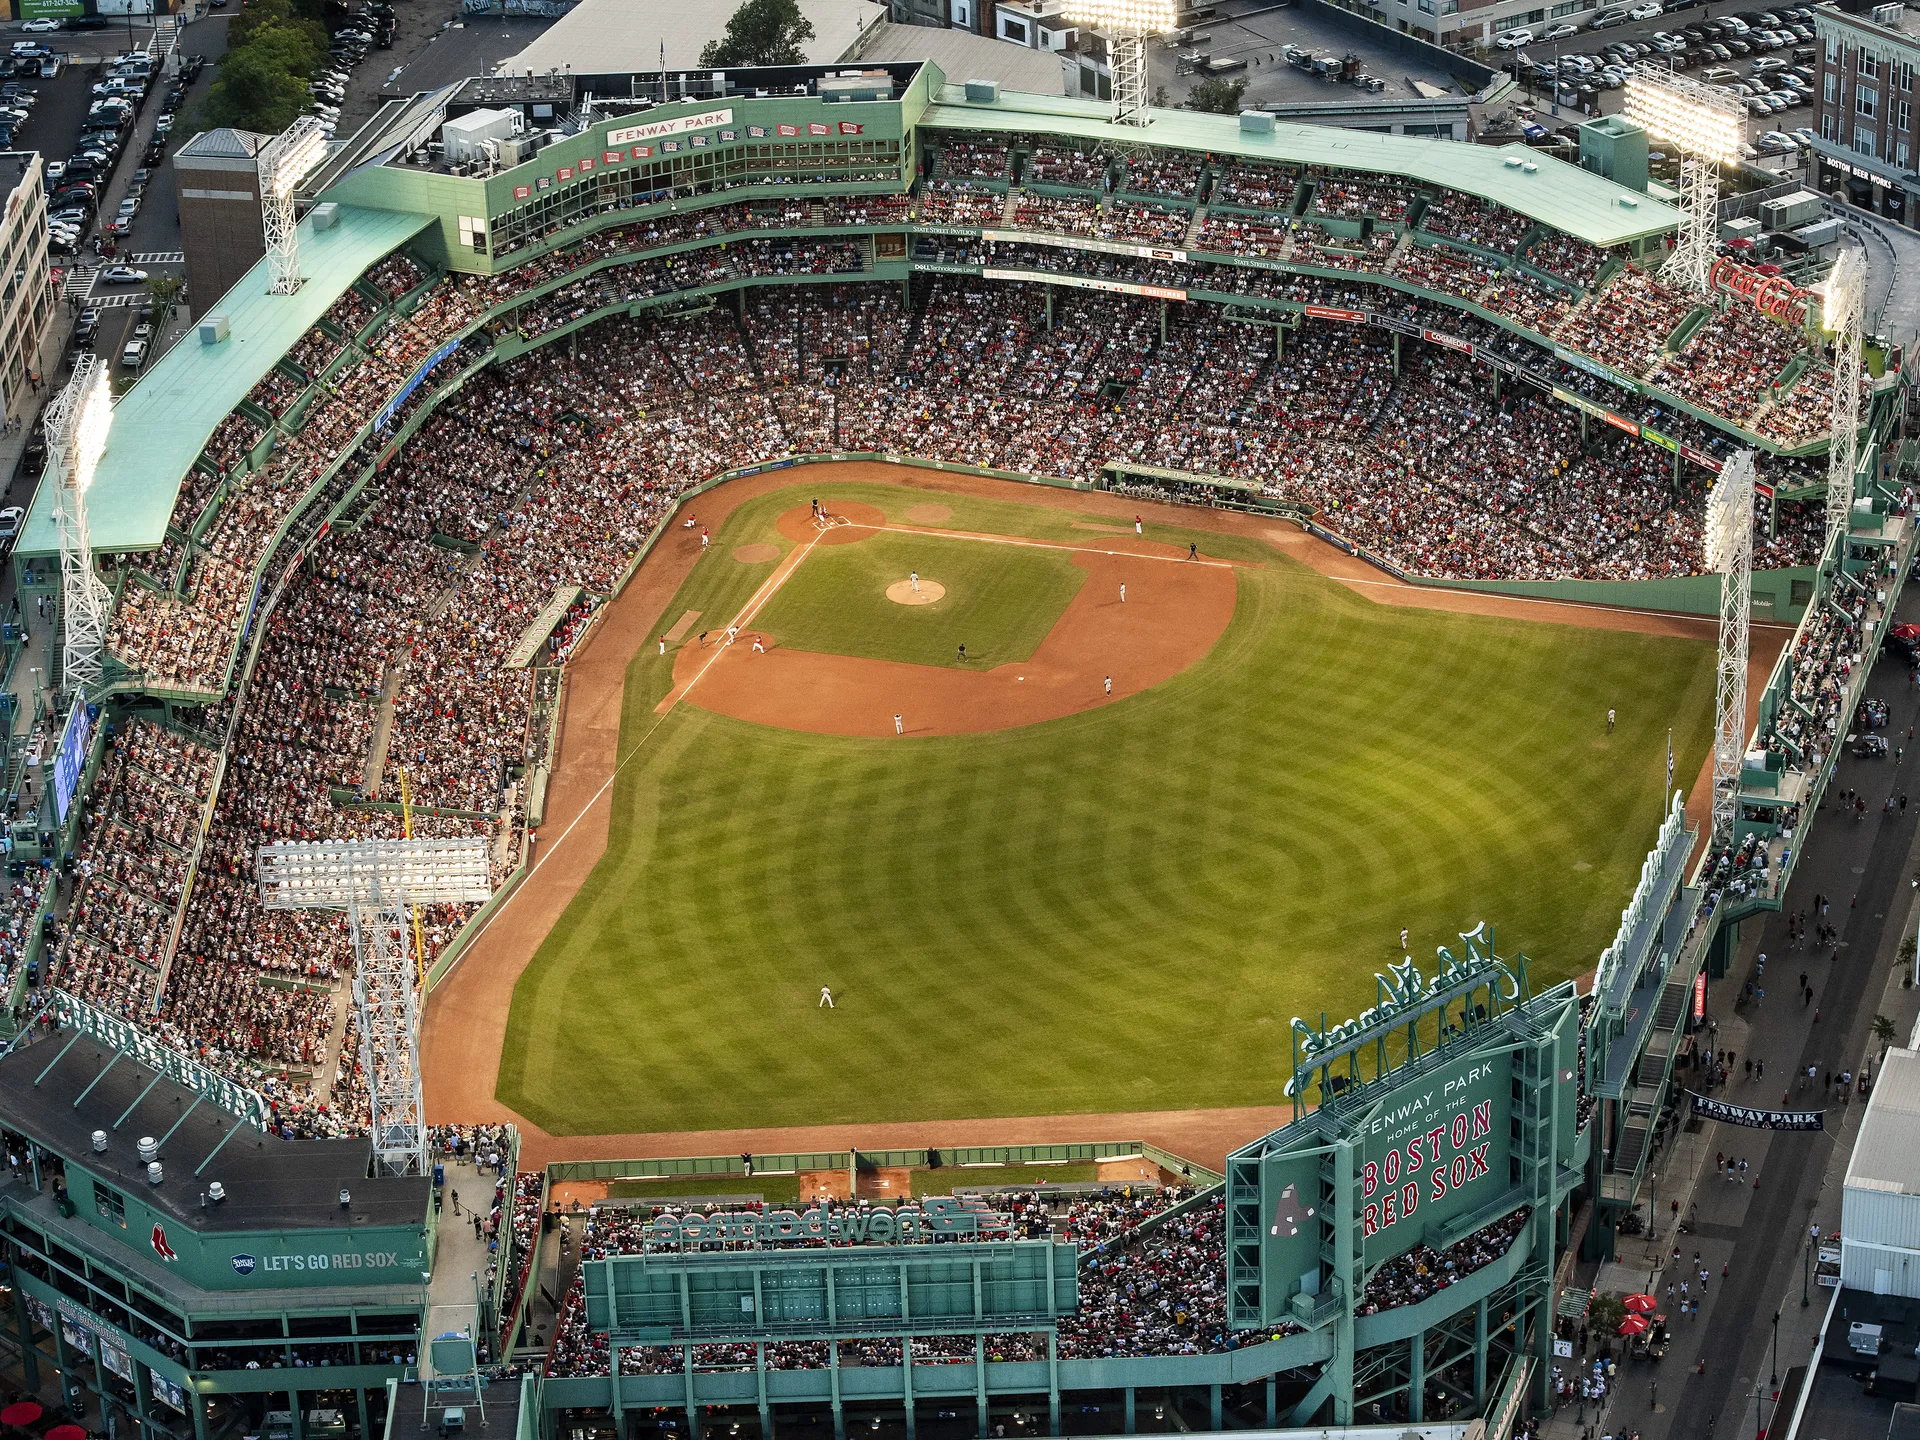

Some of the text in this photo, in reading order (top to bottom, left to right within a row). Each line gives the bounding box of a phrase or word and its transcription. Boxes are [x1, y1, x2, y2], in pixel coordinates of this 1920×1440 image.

[616, 113, 724, 141] FENWAY PARK
[1827, 157, 1891, 189] BOSTON BEER WORKS
[1709, 255, 1812, 325] Coca-Cola
[1444, 1061, 1492, 1096] PARK
[1387, 1095, 1467, 1143] HOME OF THE
[1692, 1105, 1759, 1128] LANSDOWNE
[1776, 1122, 1806, 1130] GATE
[1697, 1097, 1818, 1123] FENWAY PARK
[1361, 1099, 1491, 1200] BOSTON
[1361, 1141, 1491, 1240] RED SOX
[263, 1255, 304, 1271] LET'S
[307, 1254, 329, 1270] GO
[331, 1253, 363, 1269] RED
[365, 1252, 399, 1268] SOX
[61, 1297, 92, 1318] WELCOME
[95, 1318, 104, 1326] TO
[107, 1325, 120, 1336] THE
[1559, 1346, 1568, 1356] C
